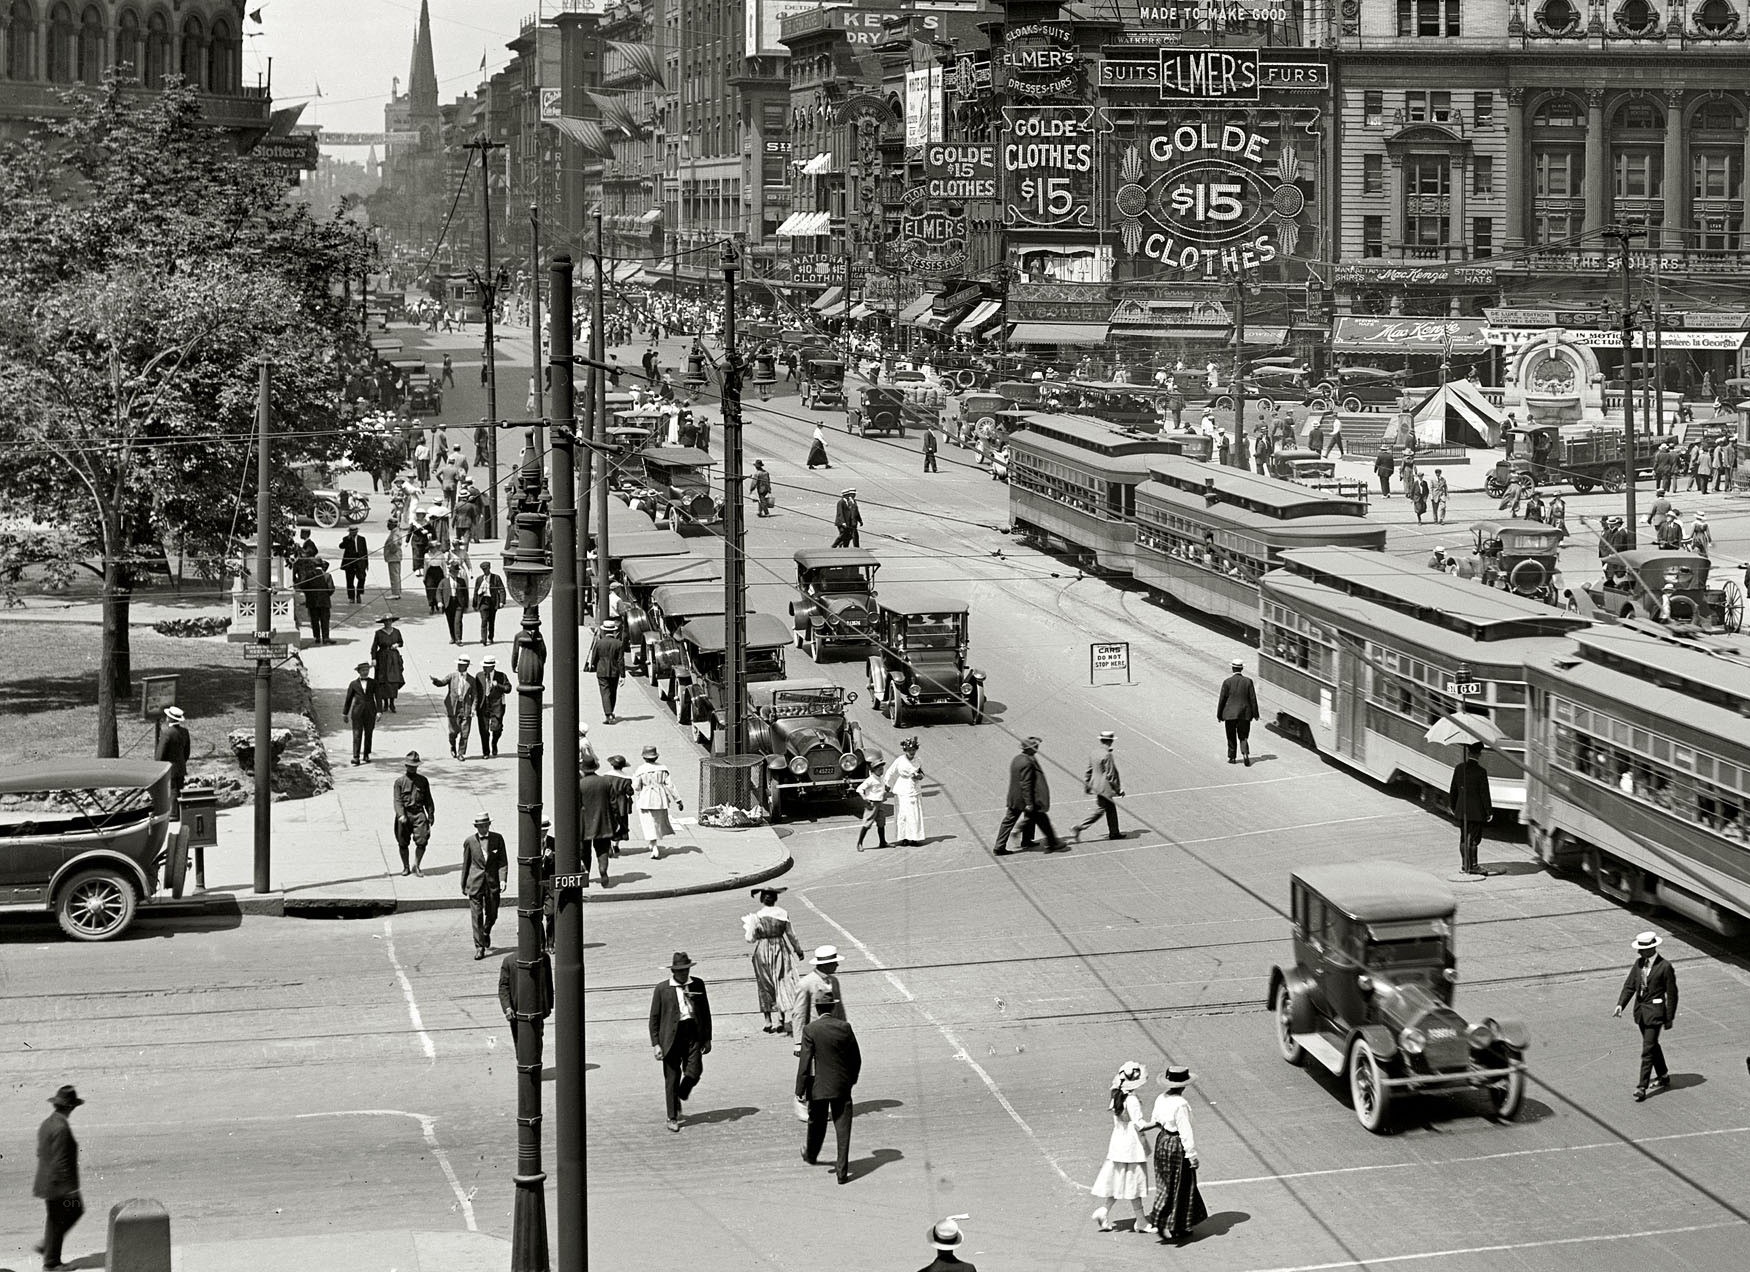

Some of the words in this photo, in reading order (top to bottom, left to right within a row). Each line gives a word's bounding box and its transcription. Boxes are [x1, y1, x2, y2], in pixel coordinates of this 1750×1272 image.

[1140, 7, 1177, 21] MADE
[1184, 7, 1200, 21] TO
[1208, 7, 1248, 21] MAKE
[1252, 7, 1287, 21] GOOD
[846, 32, 881, 44] DRY
[1003, 51, 1074, 67] ELMER'S
[1103, 66, 1158, 80] SUITS
[1164, 53, 1256, 97] ELMER'S
[1268, 68, 1319, 83] FURS
[1015, 119, 1077, 137] GOLDE
[1149, 123, 1269, 163] GOLDE
[930, 146, 994, 167] GOLDE
[1005, 144, 1091, 171] CLOTHES
[947, 163, 975, 177] $15
[929, 180, 995, 196] CLOTHES
[1021, 177, 1073, 215] $15
[1171, 182, 1244, 221] $15
[793, 254, 844, 265] NATIONA
[1144, 233, 1276, 273] CLOTHES
[1572, 258, 1601, 268] THE
[793, 274, 844, 283] CLOTHIN
[1377, 268, 1449, 284] MacKenzie
[1454, 268, 1493, 276] STETSON
[1150, 287, 1195, 297] Warner
[1460, 684, 1477, 695] GO
[554, 874, 584, 889] FORT
